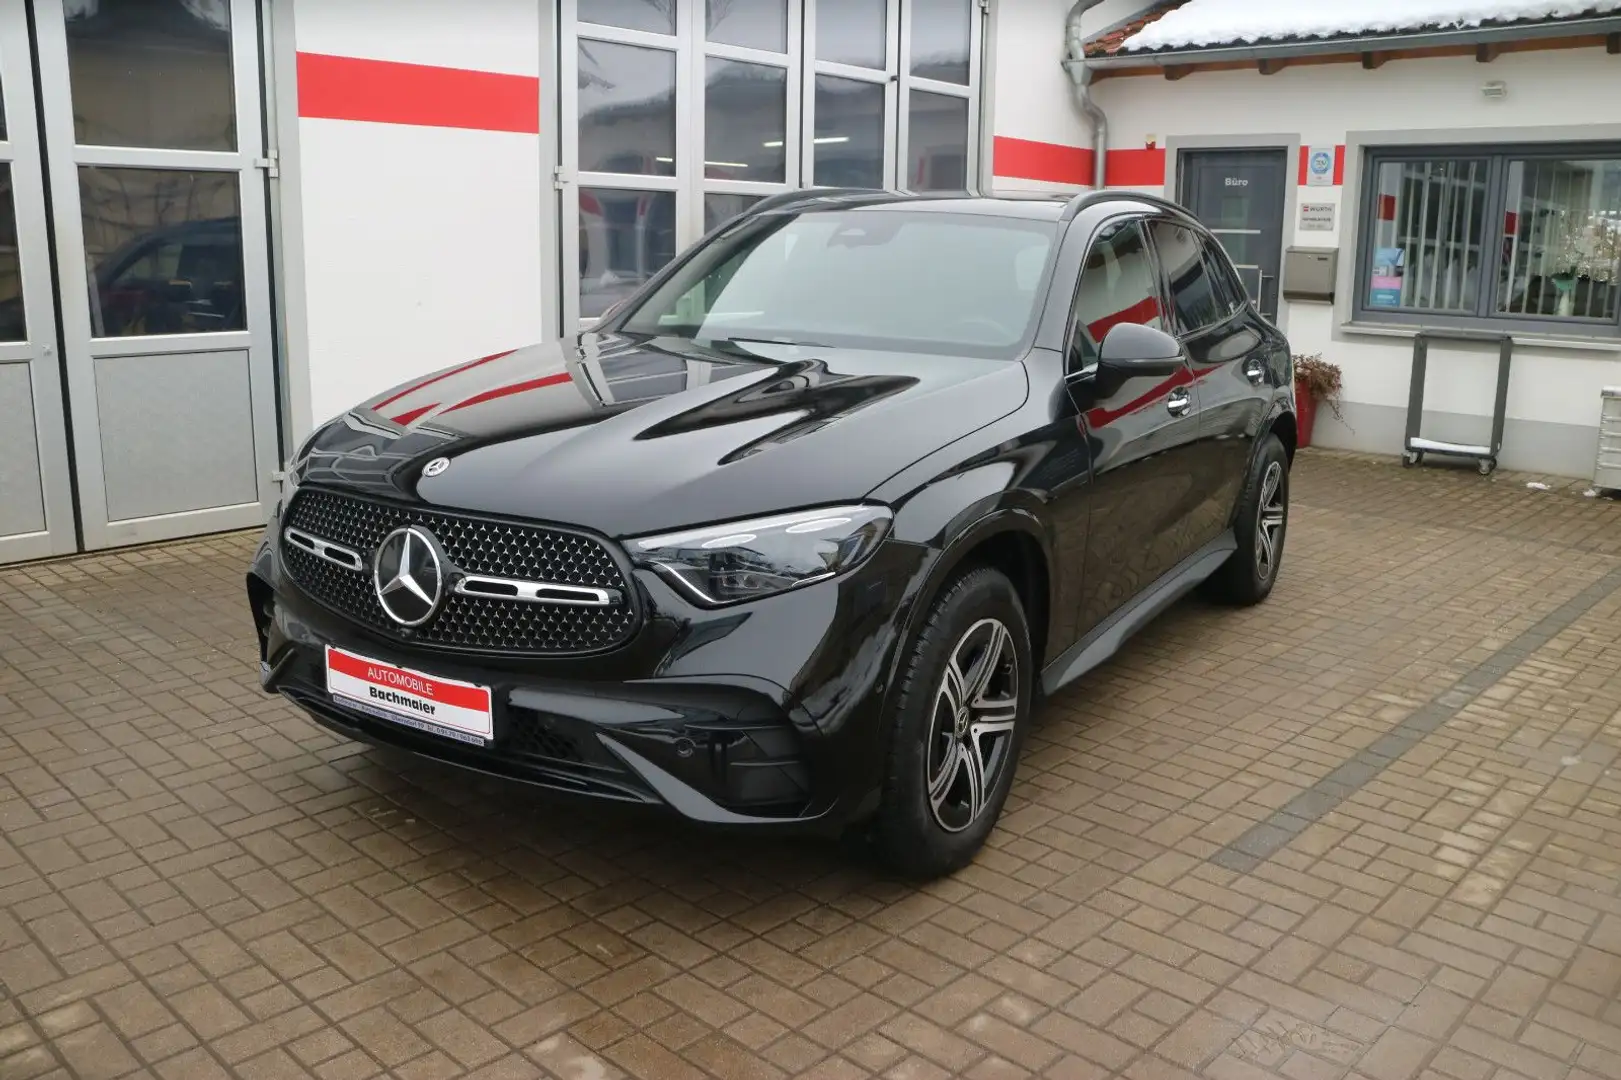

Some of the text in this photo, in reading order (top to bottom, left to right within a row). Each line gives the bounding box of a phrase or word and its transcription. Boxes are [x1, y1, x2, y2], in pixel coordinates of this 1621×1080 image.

[1224, 177, 1249, 186] Büro
[367, 666, 434, 696] AUTOMOBILE
[369, 686, 436, 715] Bachmaier
